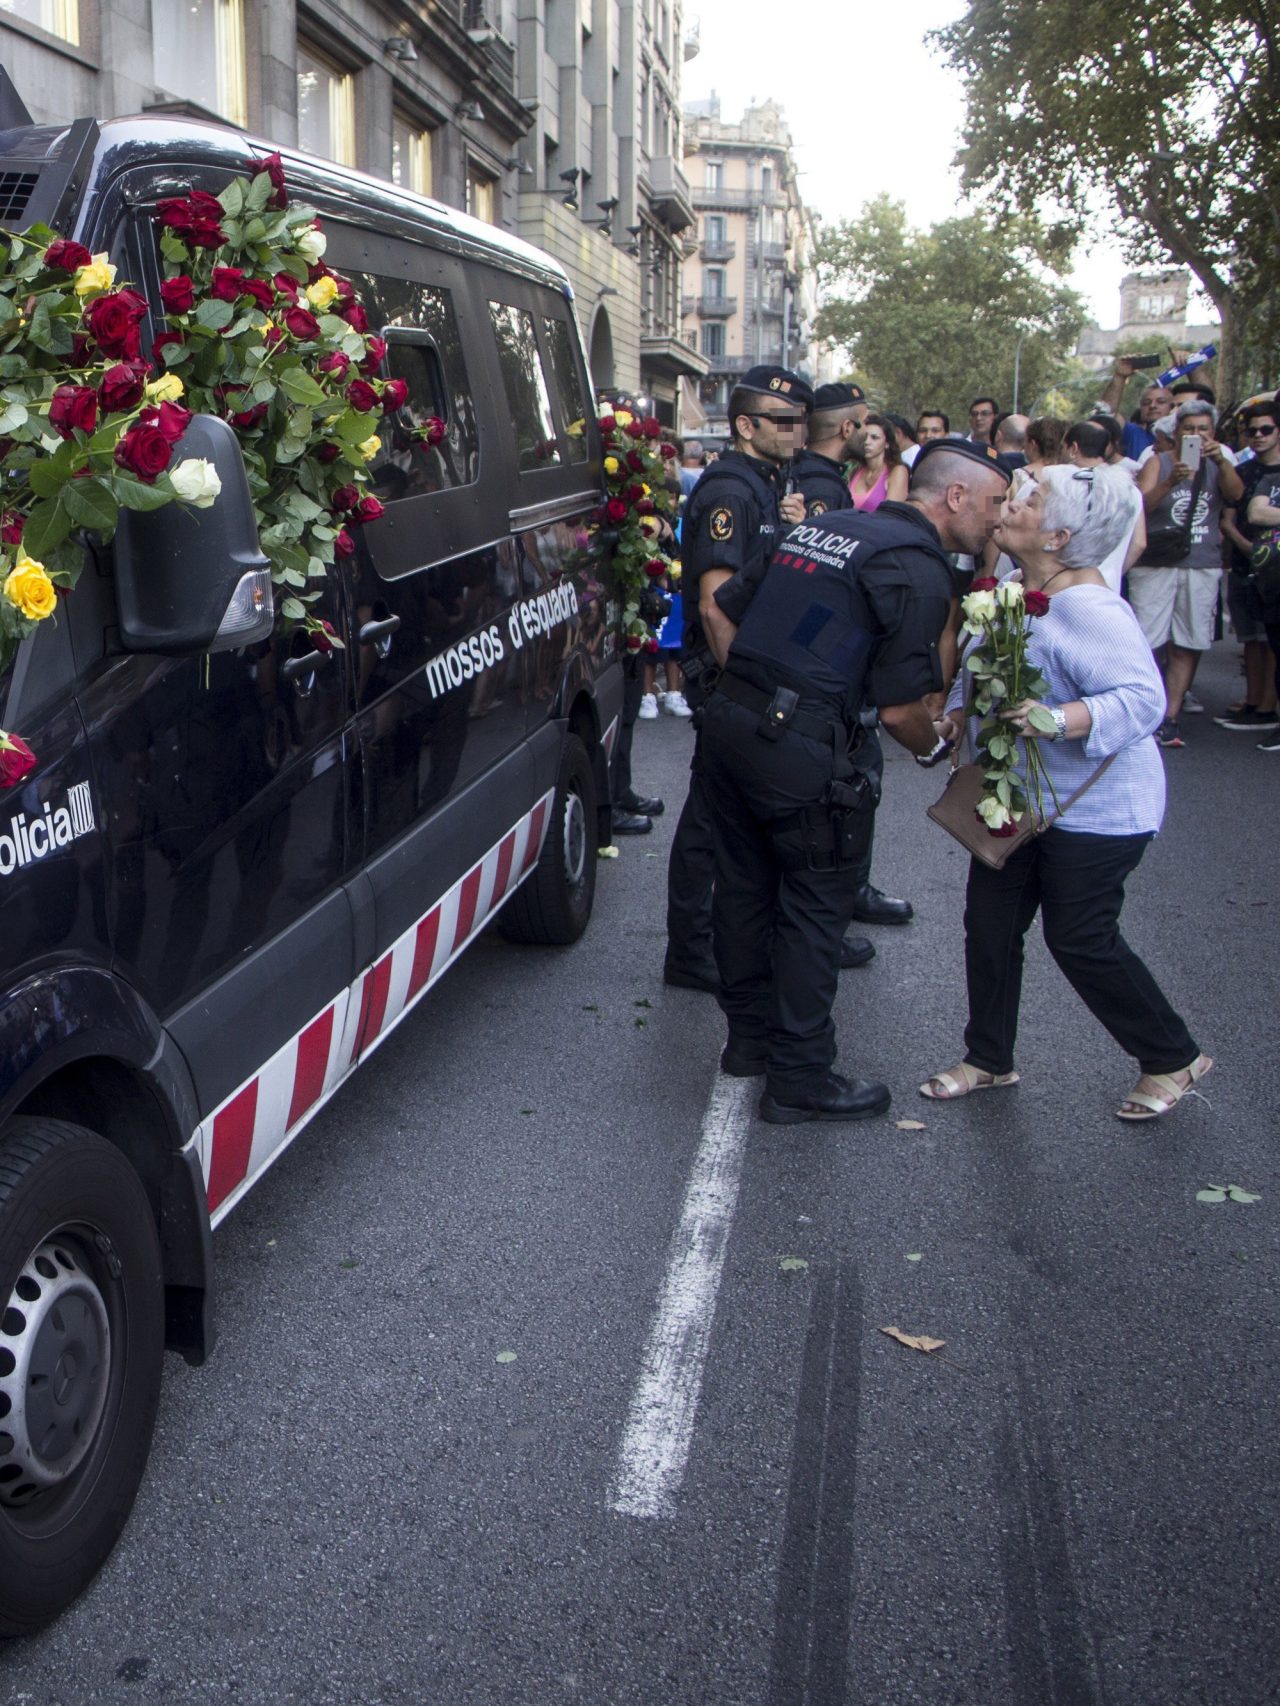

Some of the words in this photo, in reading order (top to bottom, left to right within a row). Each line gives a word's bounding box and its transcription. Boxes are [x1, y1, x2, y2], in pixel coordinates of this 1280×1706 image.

[786, 524, 860, 559] POLICIA
[426, 625, 504, 699] mossos
[508, 574, 579, 650] d'esquadra
